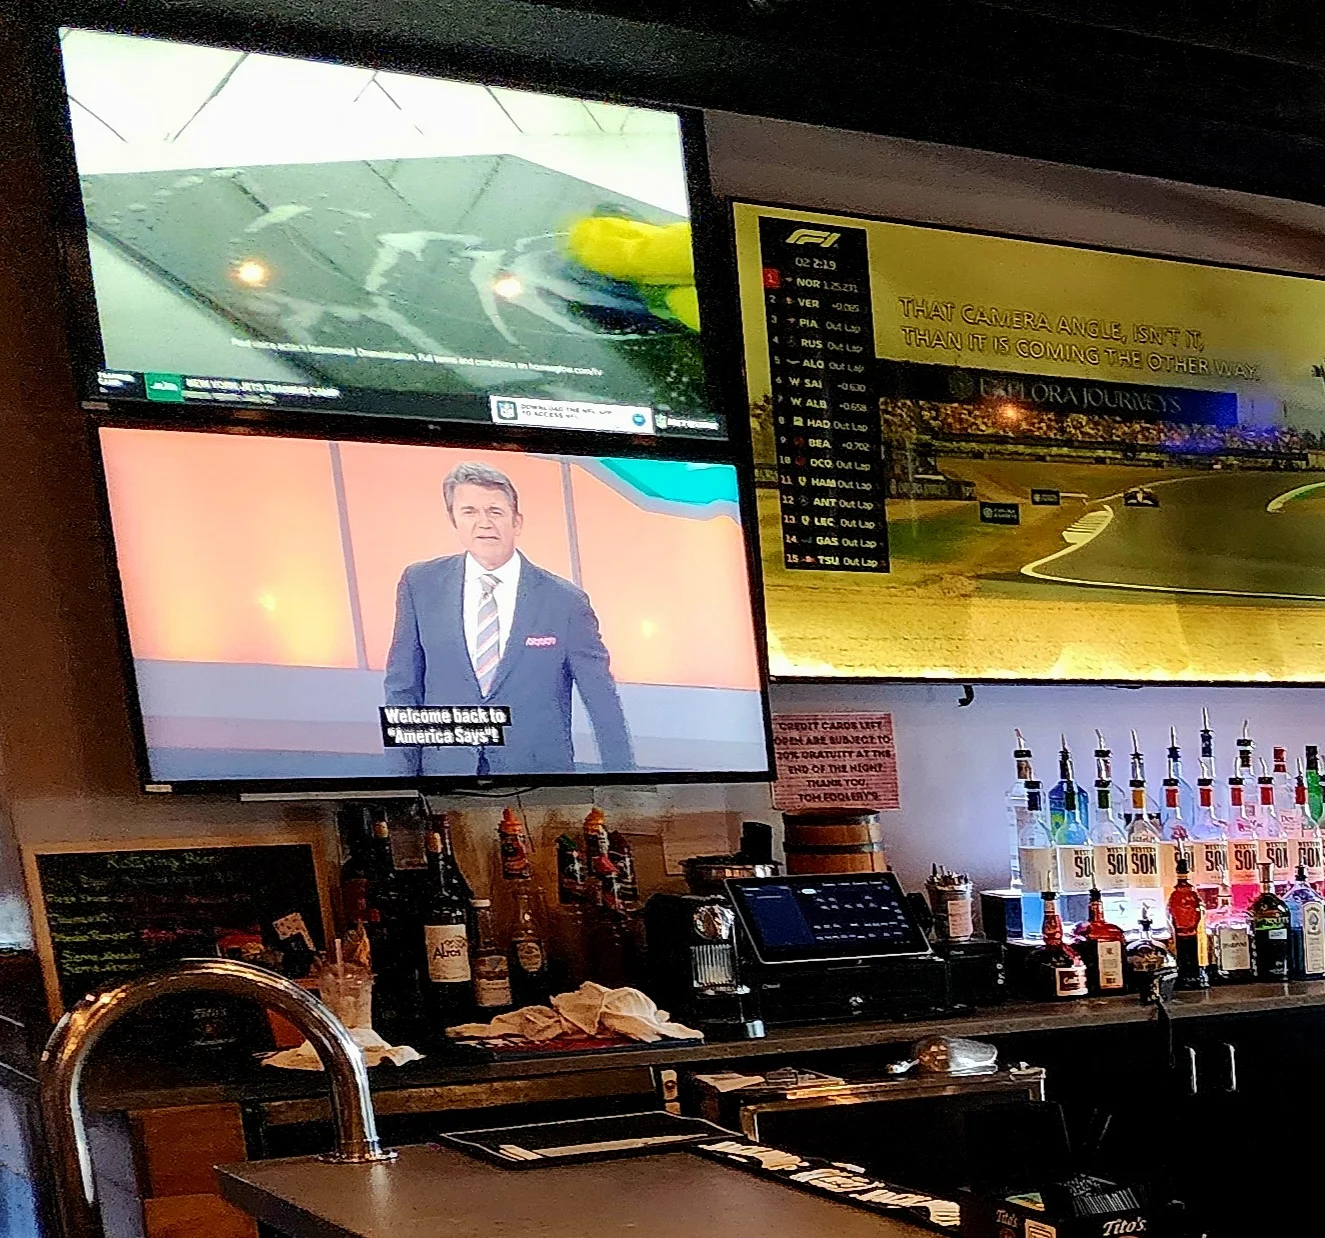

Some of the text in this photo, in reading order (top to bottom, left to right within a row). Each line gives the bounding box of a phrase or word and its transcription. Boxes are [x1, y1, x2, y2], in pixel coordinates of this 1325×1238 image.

[796, 278, 821, 289] NOR
[769, 295, 820, 308] 2 VER
[771, 315, 777, 323] 3
[799, 318, 819, 329] PIA
[826, 321, 843, 331] Out
[899, 298, 955, 322] THAT
[961, 304, 1052, 334] CAMERA
[1056, 315, 1129, 343] ANGLE,
[1132, 326, 1182, 347] ISN'T
[772, 336, 779, 344] 4
[801, 339, 823, 348] RUS
[827, 342, 844, 351] Out
[902, 326, 963, 351] THAN
[967, 332, 987, 352] IT
[991, 335, 1010, 352] IS
[1015, 338, 1100, 365] COMING
[1104, 348, 1142, 370] THE
[1147, 353, 1208, 376] OTHER
[829, 362, 846, 371] Out
[804, 378, 823, 389] SAI
[979, 376, 1182, 415] EXPLORA JOURNEYS
[805, 398, 827, 409] ALB
[807, 418, 831, 429] HAD
[833, 421, 850, 431] Out
[851, 422, 868, 432] Lap
[780, 436, 787, 444] 9
[808, 439, 832, 449] BEA
[836, 460, 853, 470] Out
[854, 461, 871, 471] Lap
[811, 477, 837, 488] HAM
[837, 480, 854, 490] Out
[855, 480, 872, 490] Lap
[782, 495, 874, 511] 12 ANT Out Lap
[783, 515, 876, 530] 13 LEC Out Lap
[785, 534, 877, 549] 14 GAS Out Lap
[786, 553, 878, 568] 15 TSU Out Lap
[384, 707, 507, 725] Welcome back to
[821, 721, 858, 730] CARDS
[859, 720, 883, 730] LEFT
[774, 735, 892, 746] OPEN ARE SUBJECT TO
[802, 750, 855, 759] GRATUITY
[856, 750, 869, 758] AT
[872, 750, 892, 758] THE
[788, 763, 883, 774] END OF THE NIGHT
[806, 779, 842, 788] THANK
[798, 793, 821, 802] TOM
[1132, 853, 1158, 875] SON
[996, 1209, 1018, 1228] Tito's
[1103, 1216, 1148, 1236] Tito's
